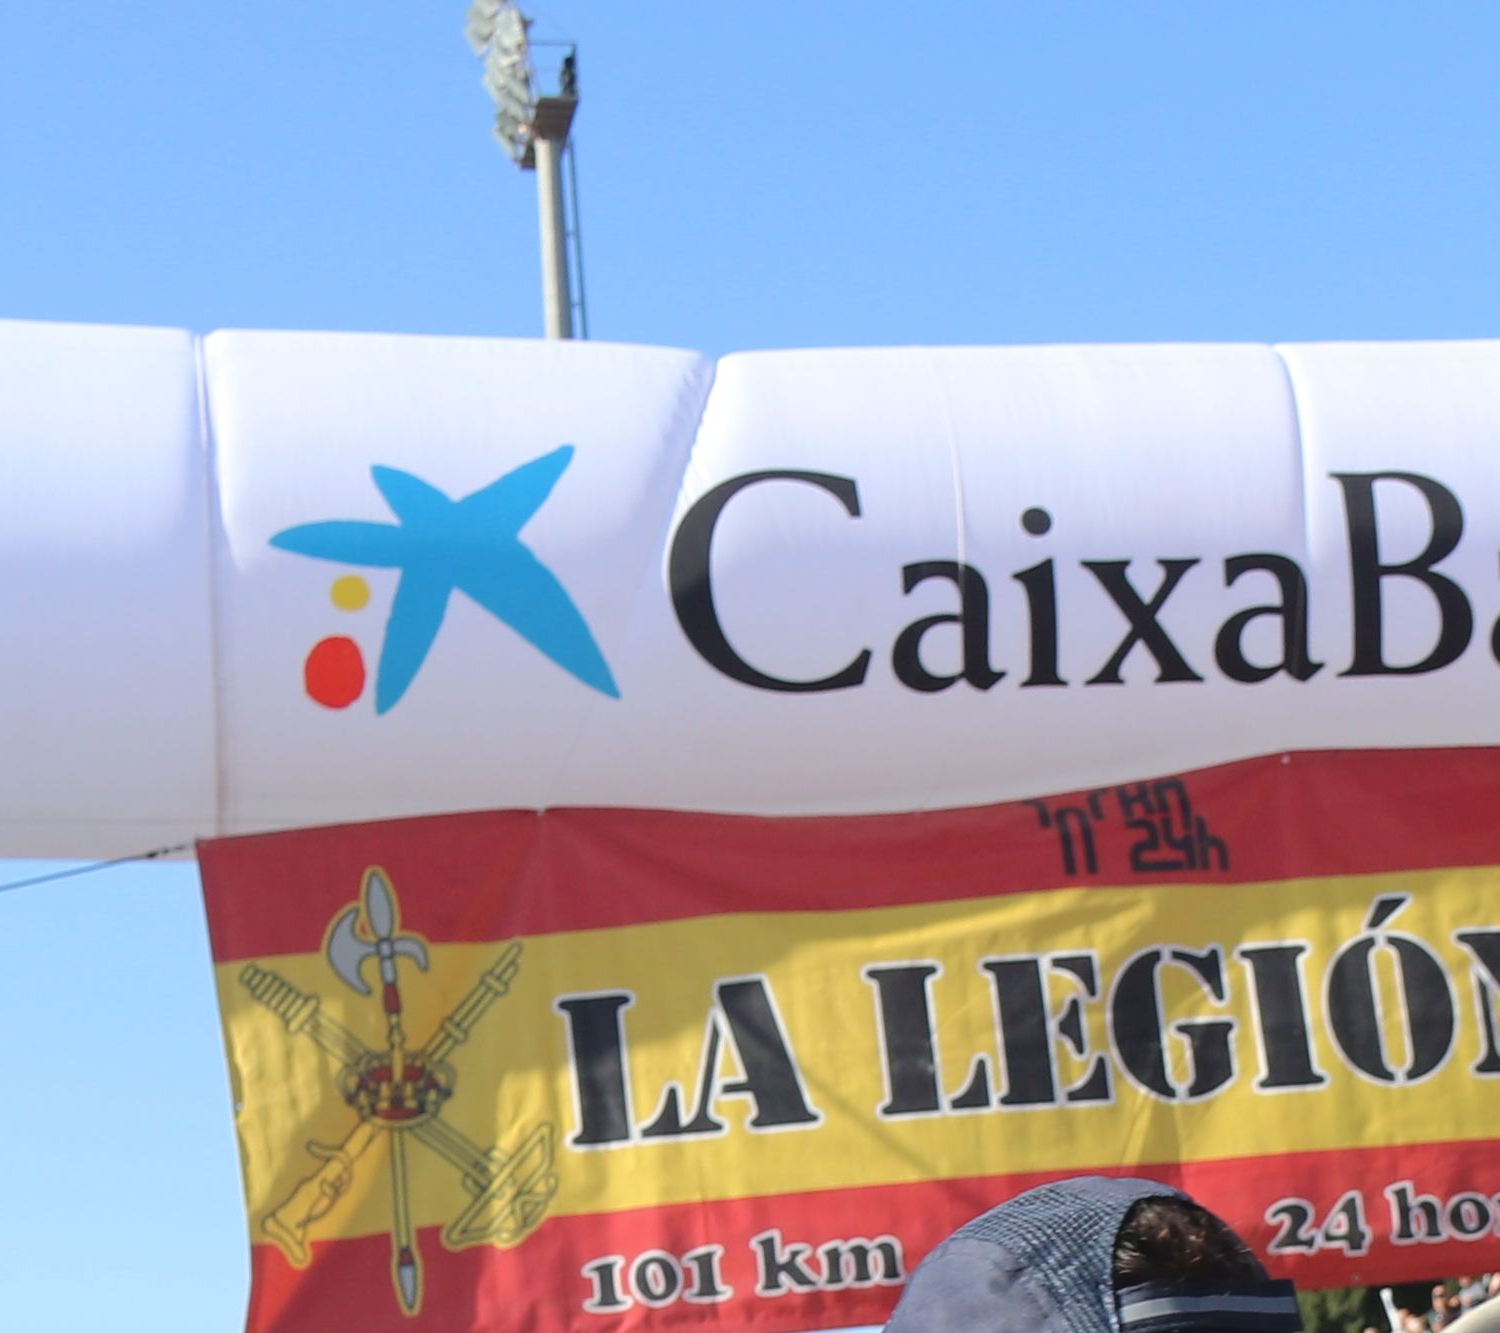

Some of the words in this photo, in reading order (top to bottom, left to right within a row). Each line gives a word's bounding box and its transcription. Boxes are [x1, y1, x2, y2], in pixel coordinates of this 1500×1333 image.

[558, 978, 820, 1148] LA
[583, 1248, 724, 1313] 101
[753, 1230, 903, 1294] km
[1267, 1191, 1368, 1256] 24
